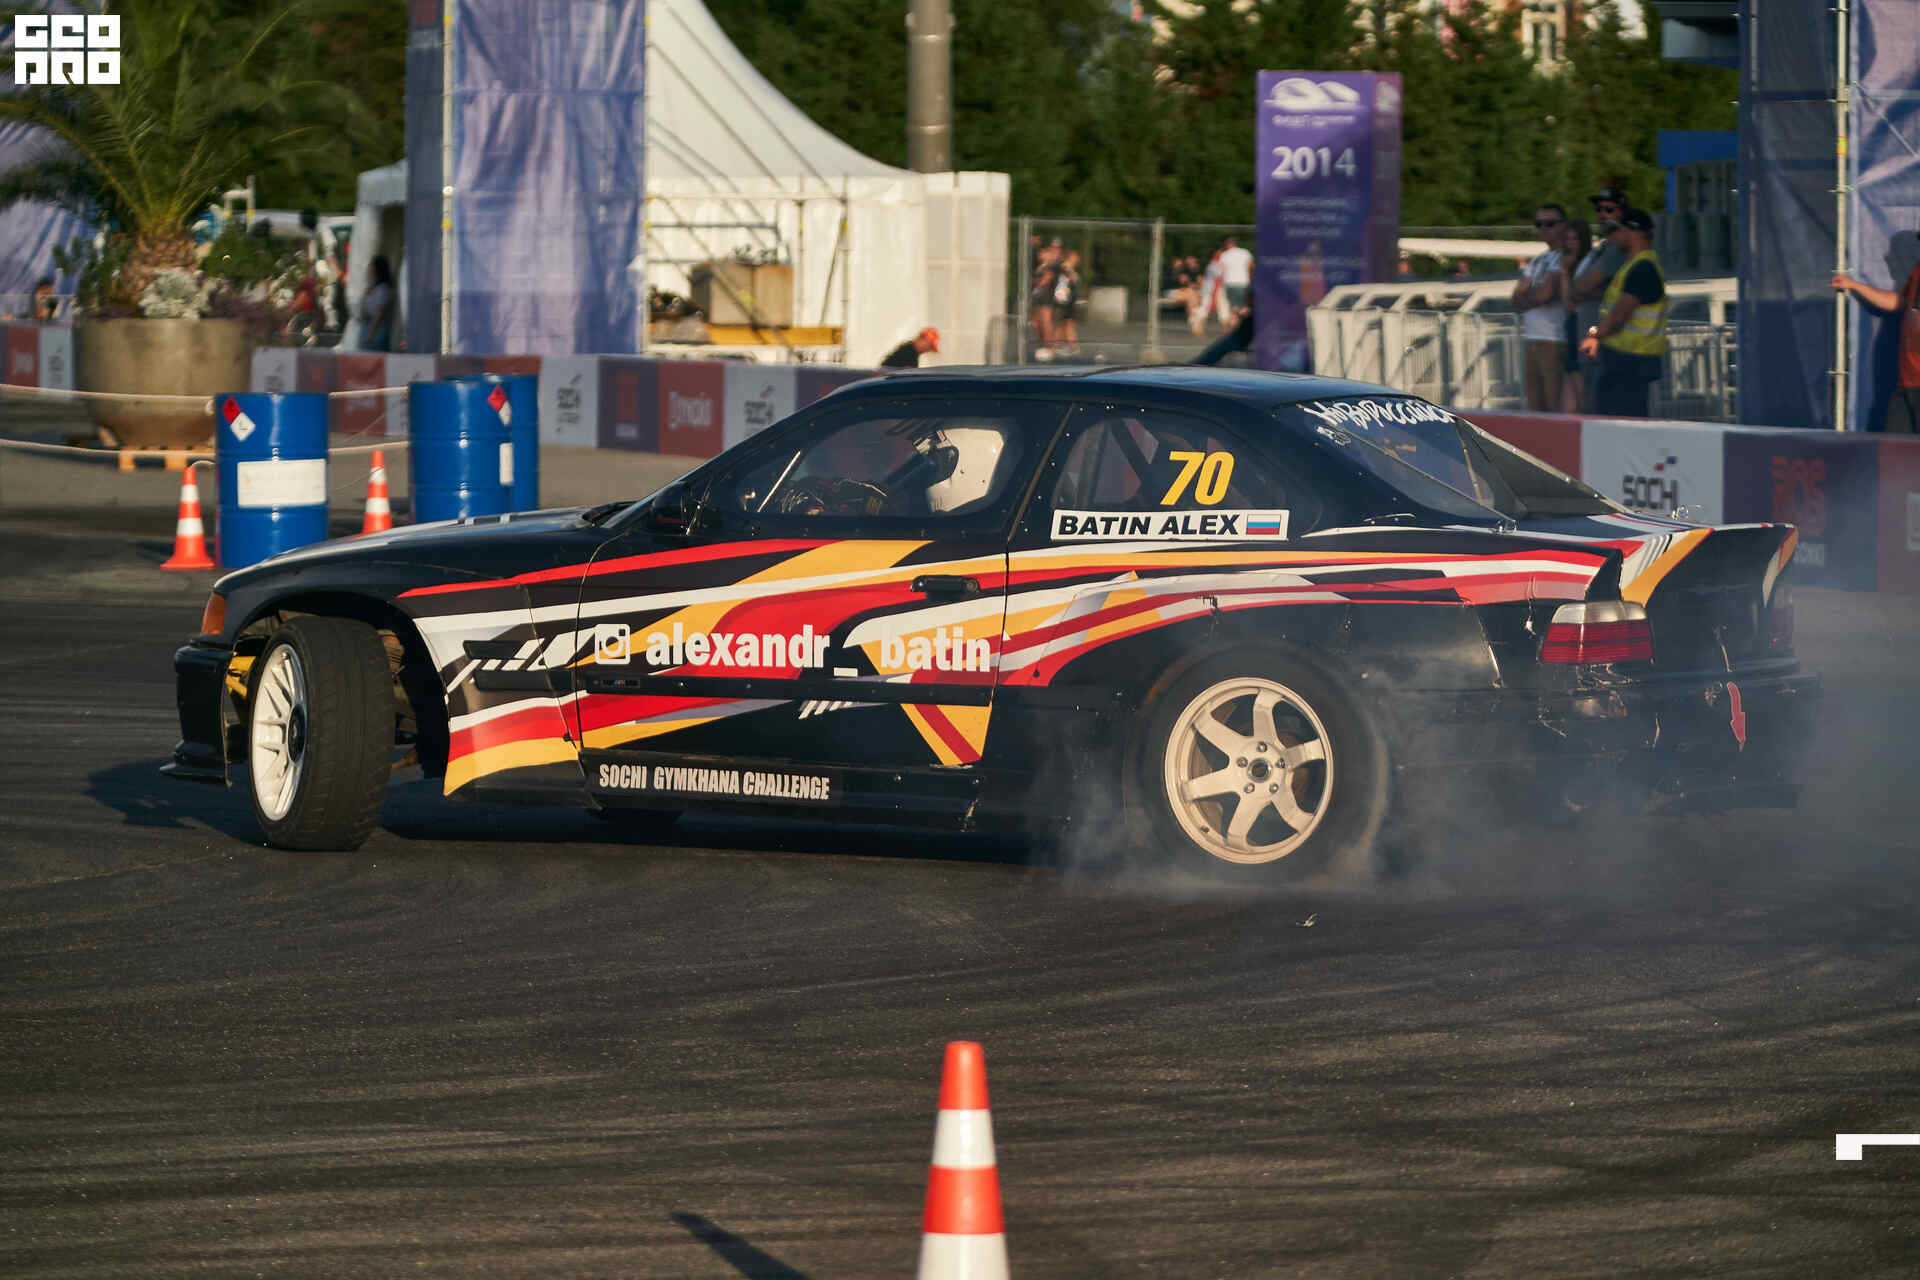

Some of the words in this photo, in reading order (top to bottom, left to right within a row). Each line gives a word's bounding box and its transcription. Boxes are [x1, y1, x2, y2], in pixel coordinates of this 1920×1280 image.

[1271, 146, 1357, 180] 2014
[1160, 450, 1235, 506] 70
[1622, 475, 1678, 510] SOCHI
[1058, 515, 1151, 536] BATIN
[1158, 514, 1240, 536] ALEX
[600, 764, 648, 789] SOCHI
[653, 766, 740, 794] GYMKHANA
[743, 771, 830, 800] CHALLENGE
